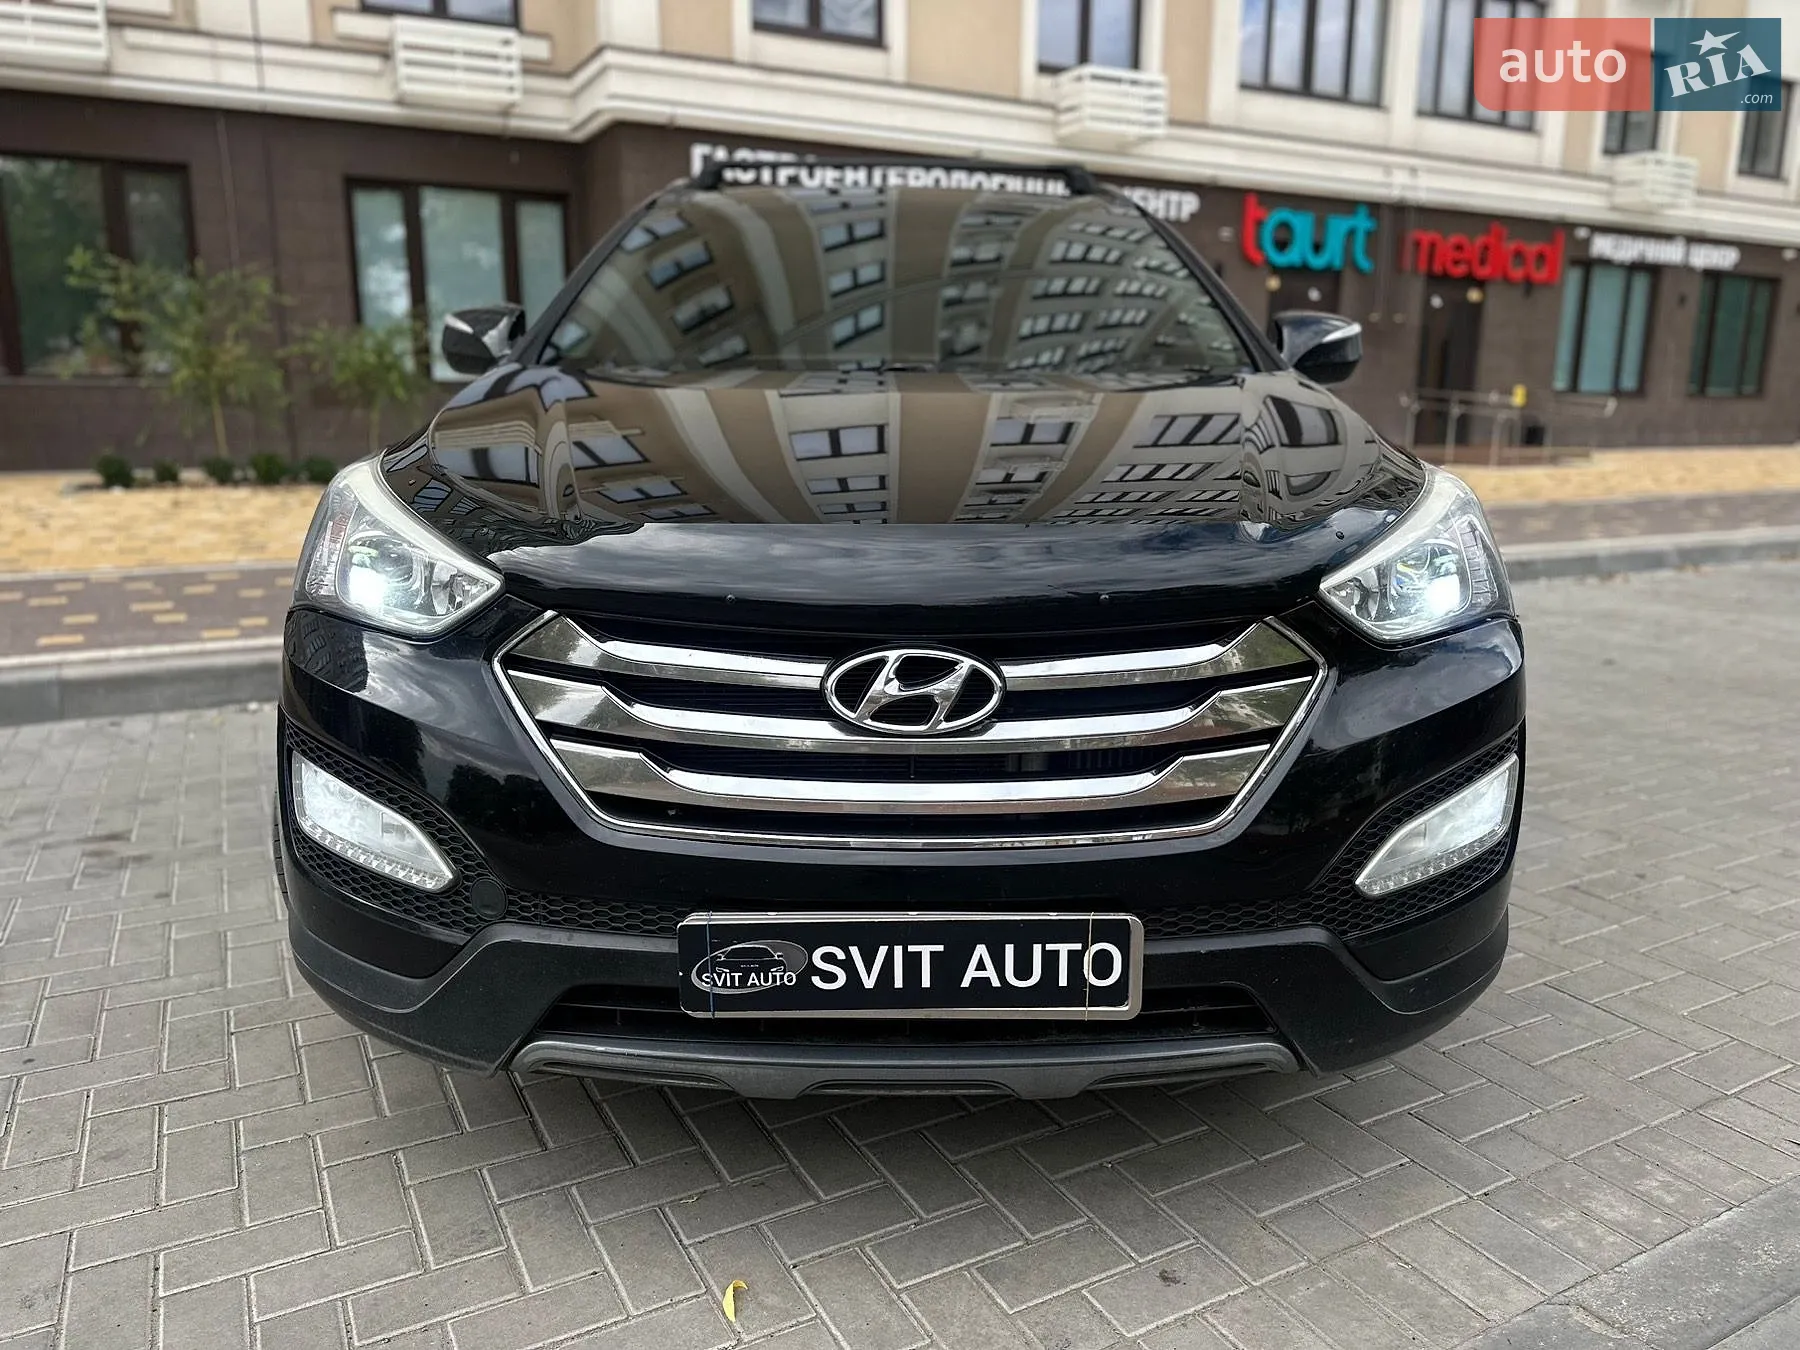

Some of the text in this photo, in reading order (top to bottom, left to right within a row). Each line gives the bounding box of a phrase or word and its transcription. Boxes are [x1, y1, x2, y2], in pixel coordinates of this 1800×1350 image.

[1241, 192, 1565, 285] taurt medical
[701, 971, 797, 987] SVIT AUTO
[811, 942, 1123, 989] SVIT AUTO
